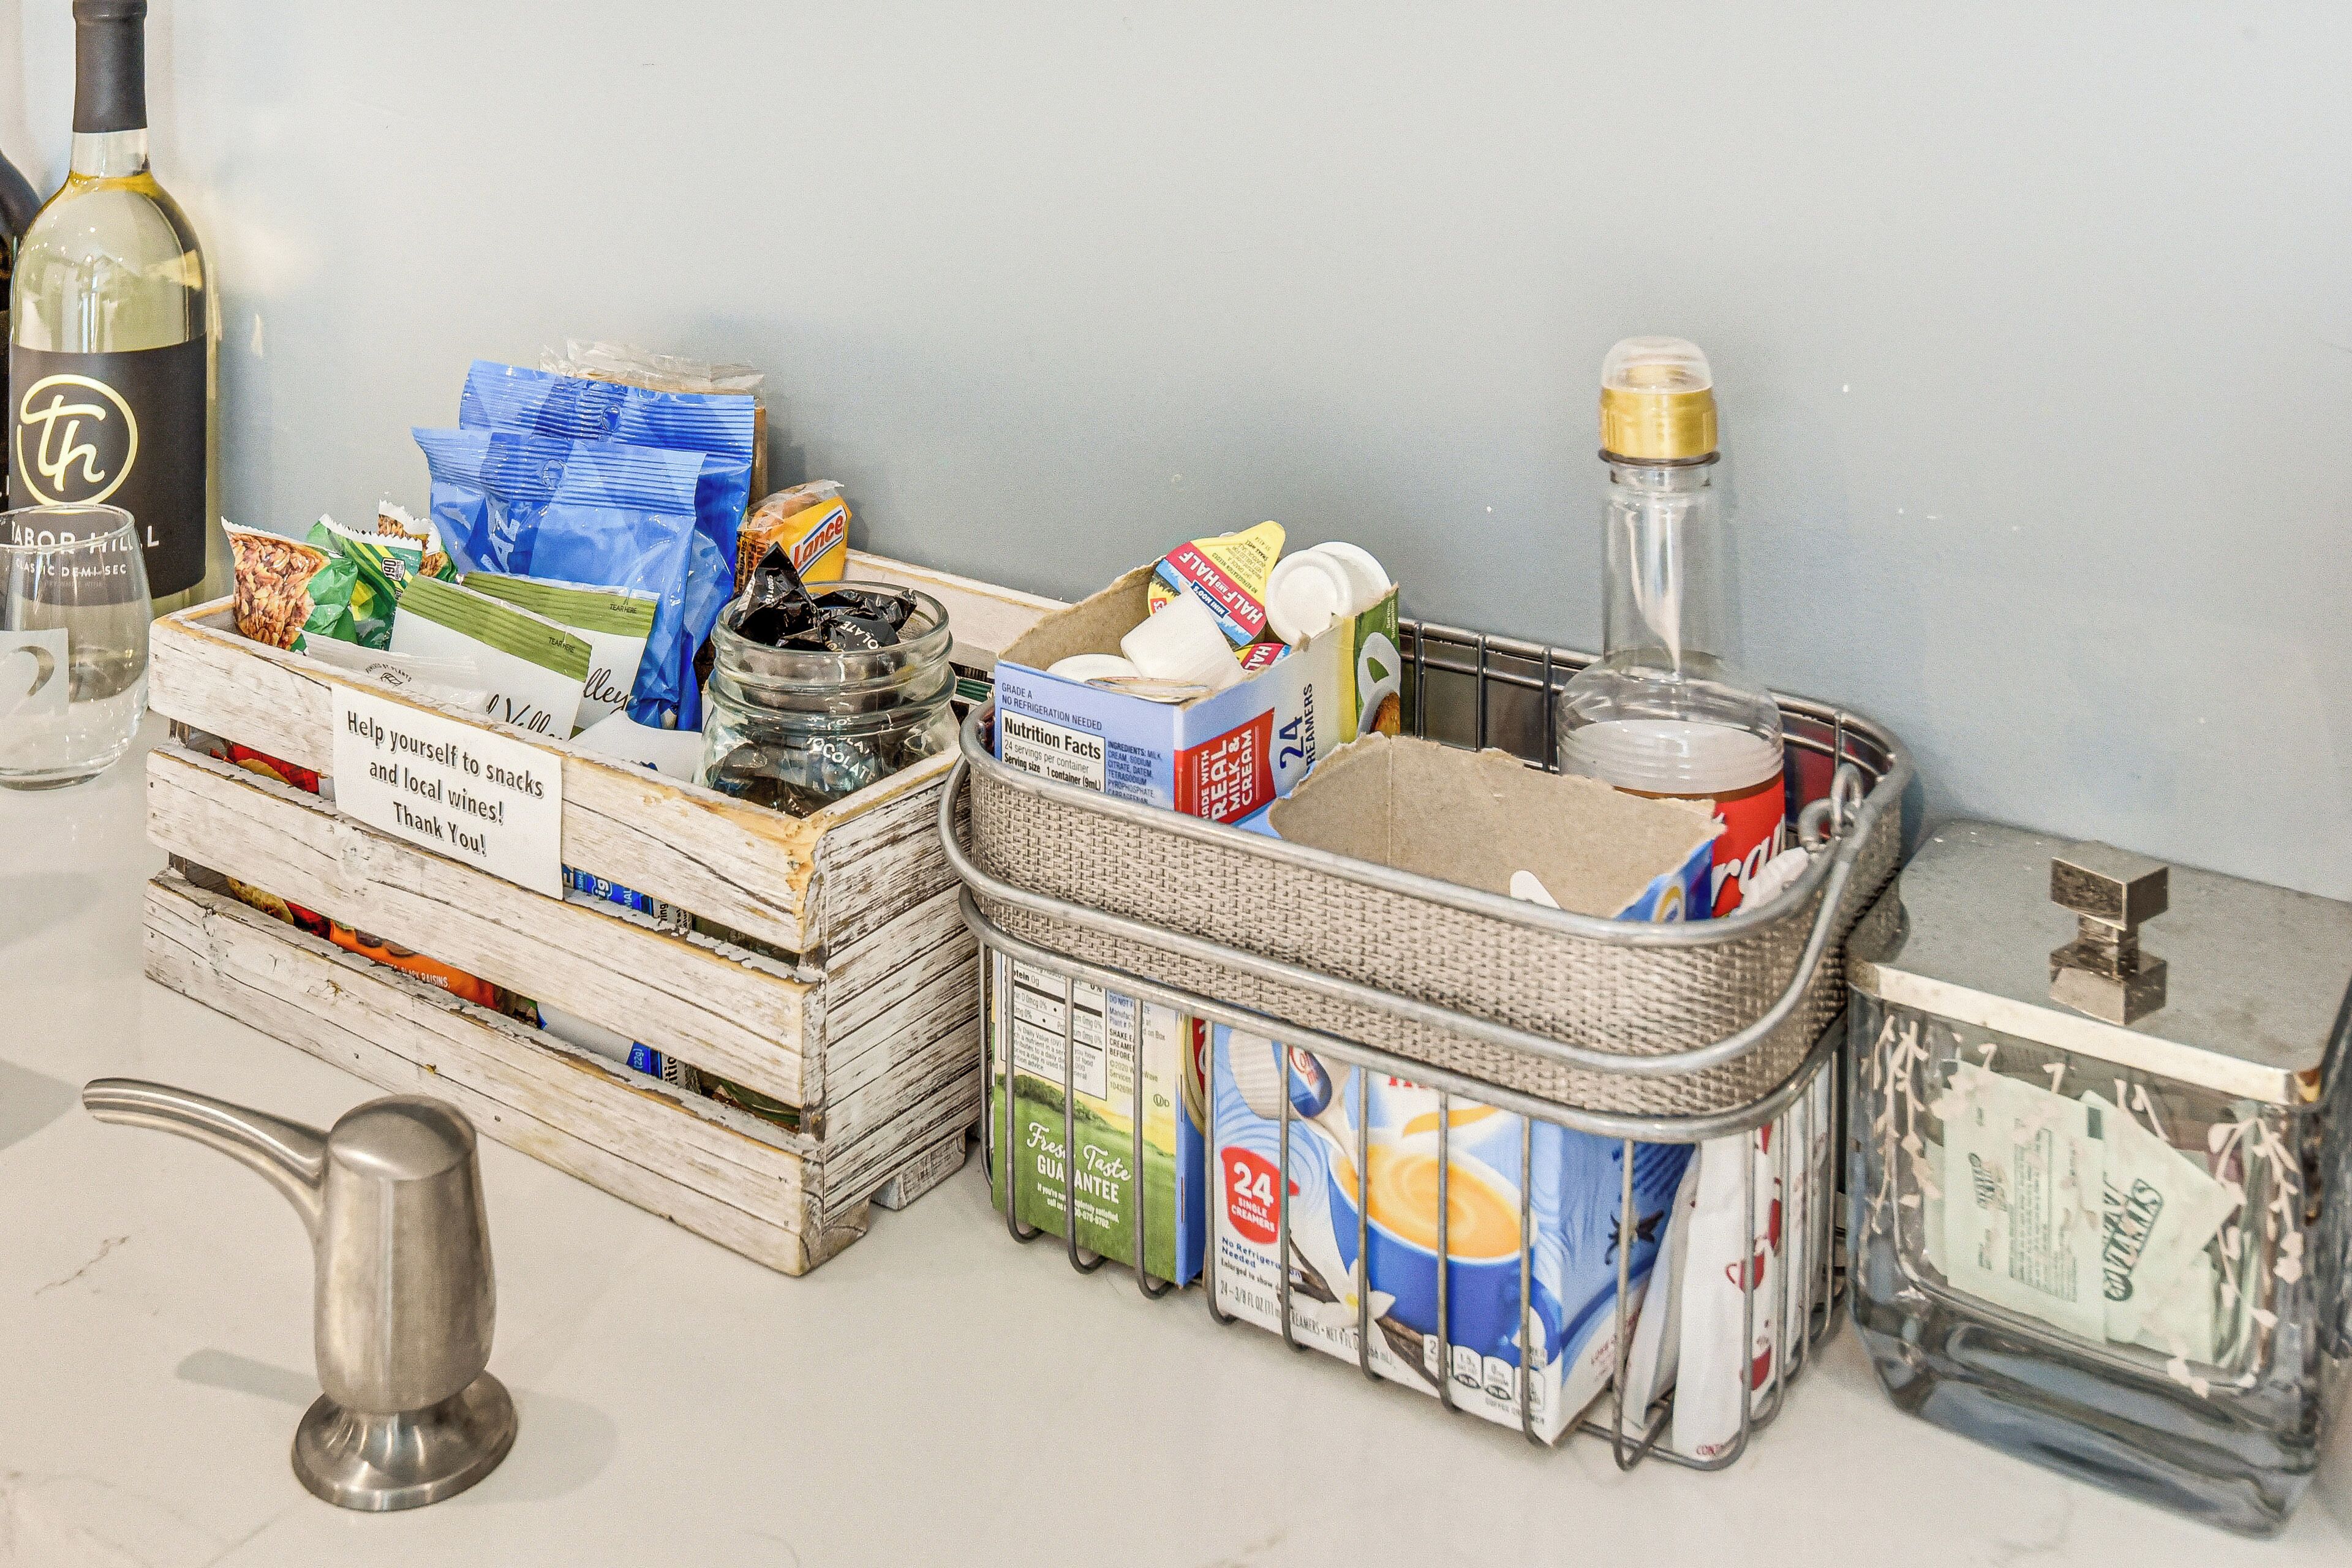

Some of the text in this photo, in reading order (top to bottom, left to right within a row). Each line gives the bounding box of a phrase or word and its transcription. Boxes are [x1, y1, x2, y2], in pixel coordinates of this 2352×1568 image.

[793, 514, 845, 568] Lance
[383, 559, 396, 578] 190
[1212, 552, 1227, 567] NEEDED
[1178, 550, 1264, 625] HALF AND HALF
[1226, 565, 1252, 589] REFRIGERATION
[609, 603, 624, 612] TEAR
[1193, 585, 1226, 616] MINI MOO'S
[548, 636, 576, 654] TEAR HERE
[1244, 645, 1273, 670] HAL
[583, 668, 629, 715] lley
[1002, 682, 1026, 698] GRADE
[1027, 691, 1033, 699] A
[1002, 695, 1102, 731] NO REFRIGERATION NEEDED
[1303, 683, 1316, 767] REAMERS
[1005, 717, 1101, 760] Nutrition Facts
[1107, 741, 1146, 756] INGREDIENTS:
[1279, 715, 1304, 769] 24
[347, 710, 544, 798] Help yourself to snacks
[1005, 739, 1089, 774] 24 servings per container
[1129, 755, 1152, 767] SODIUM
[1242, 729, 1253, 806] CREAM
[1005, 753, 1101, 792] Serving size 1 container (9mL)
[1107, 769, 1147, 785] TETRASODIUM
[1210, 739, 1227, 820] REAL
[1229, 736, 1240, 812] MILK &
[369, 761, 505, 824] and local wines!
[393, 801, 487, 856] Thank You!
[1031, 976, 1039, 987] 0g
[1109, 995, 1129, 1008] DO NOT
[1036, 1031, 1049, 1043] Value
[1109, 1028, 1128, 1040] SHAKE
[1109, 1038, 1134, 1052] CREAME
[1109, 1047, 1131, 1061] BEFORE
[1027, 1122, 1131, 1182] Fres Taste
[1037, 1154, 1119, 1205] GUAANTEE
[1233, 1161, 1275, 1208] 24
[1231, 1204, 1275, 1233] CREAMERS
[1238, 1196, 1268, 1219] SINGLE
[1221, 1245, 1256, 1268] Needed
[1221, 1236, 1302, 1278] No Refrigeraon
[1291, 1310, 1320, 1335] REAMERS
